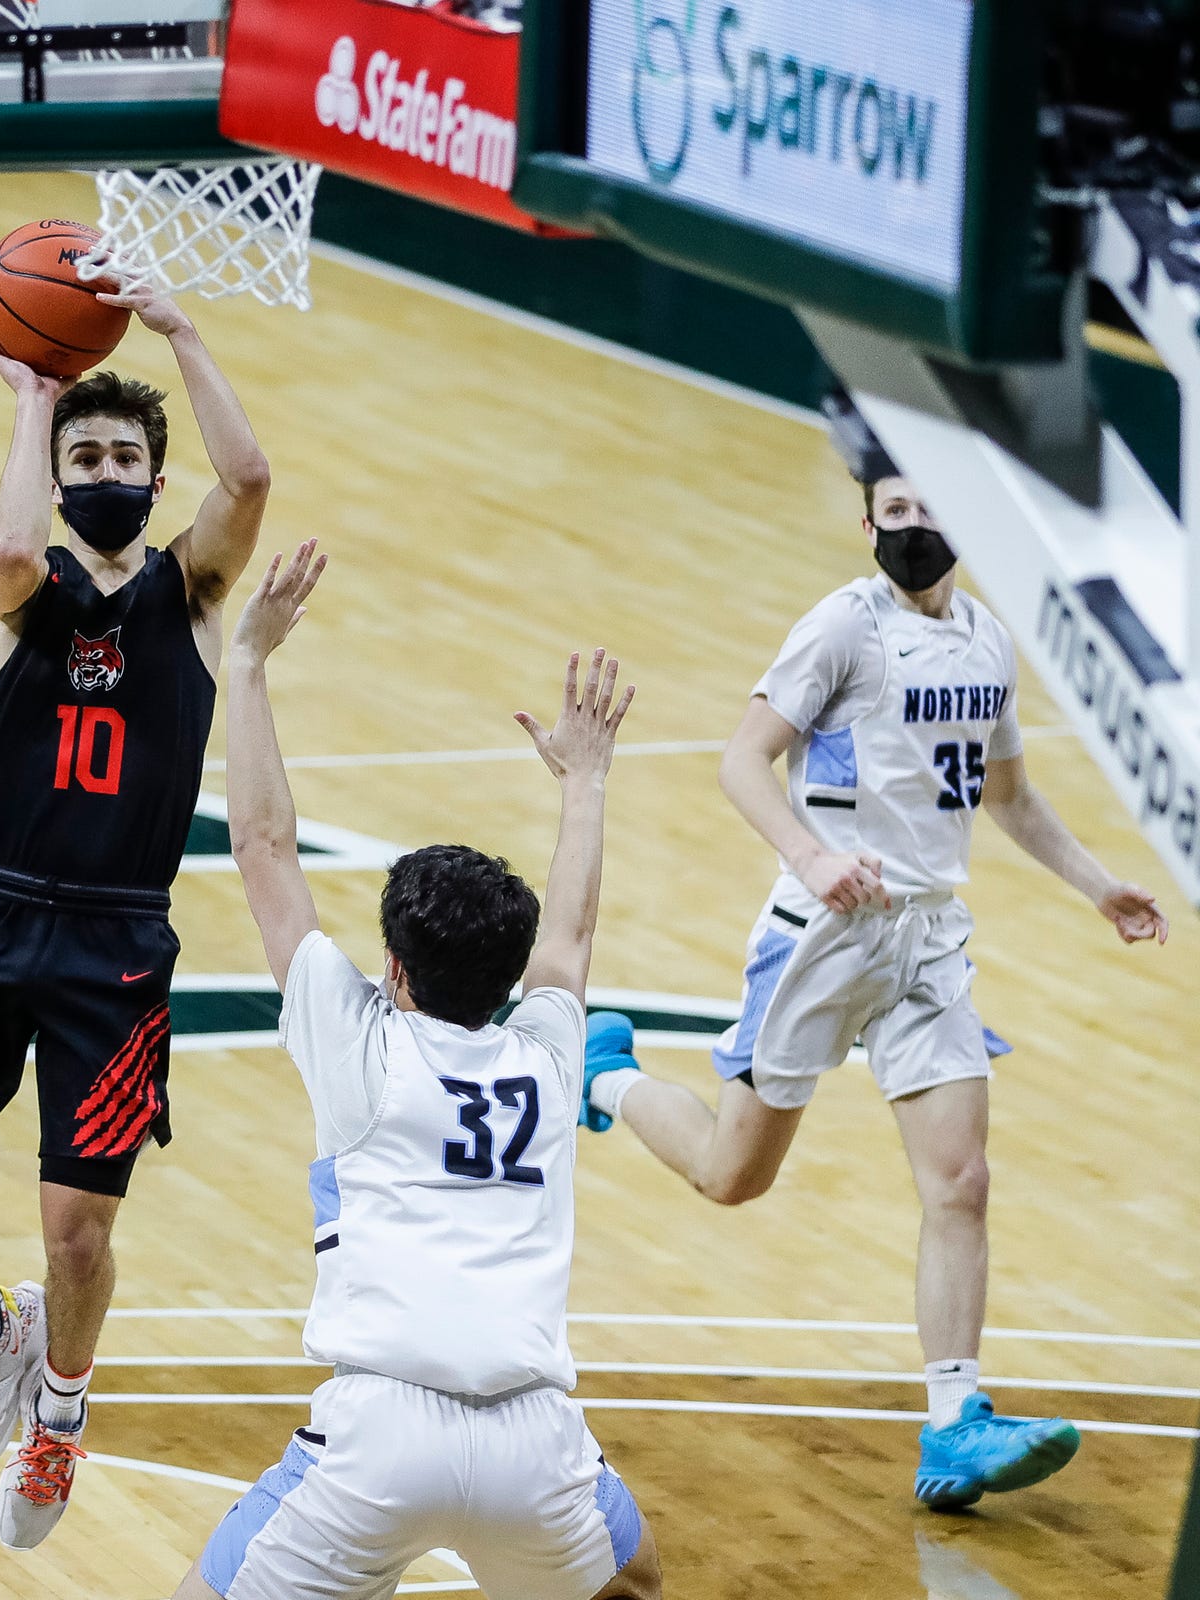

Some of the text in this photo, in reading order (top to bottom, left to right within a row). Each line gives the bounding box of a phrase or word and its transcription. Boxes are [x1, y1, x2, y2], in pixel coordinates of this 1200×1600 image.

[710, 6, 935, 184] Sparrow
[53, 703, 127, 795] 10
[933, 740, 986, 811] 35
[437, 1074, 545, 1188] 32
